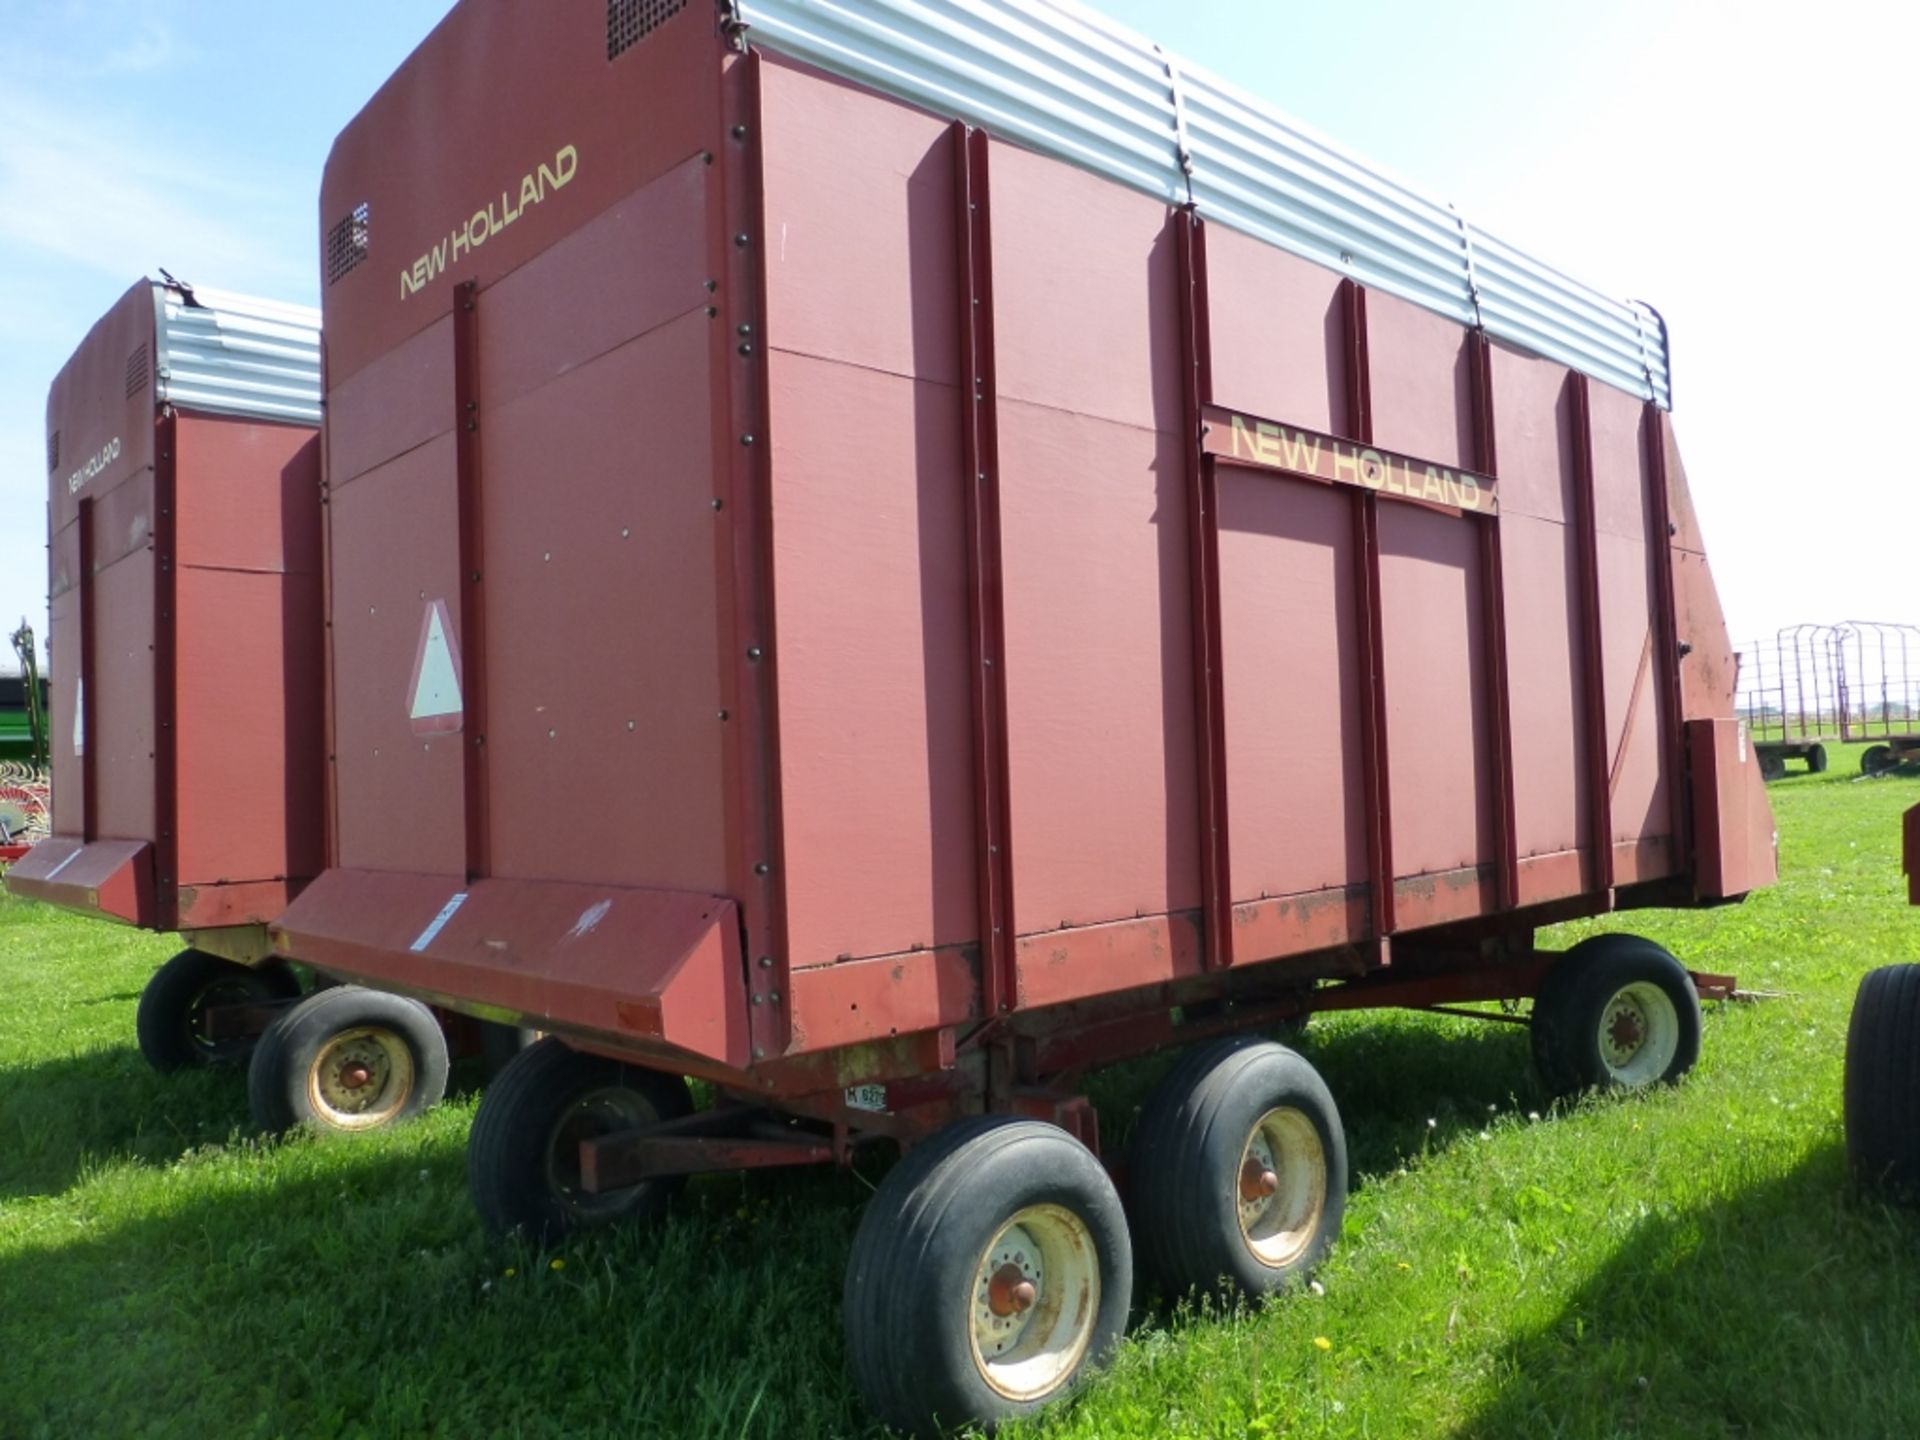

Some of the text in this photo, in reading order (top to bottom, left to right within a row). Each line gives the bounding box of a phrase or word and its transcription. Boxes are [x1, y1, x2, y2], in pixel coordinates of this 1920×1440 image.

[400, 144, 577, 300] NEW HOLLAND
[68, 436, 120, 496] NEW HOLLAND
[1231, 415, 1480, 509] NEW HOLLAND
